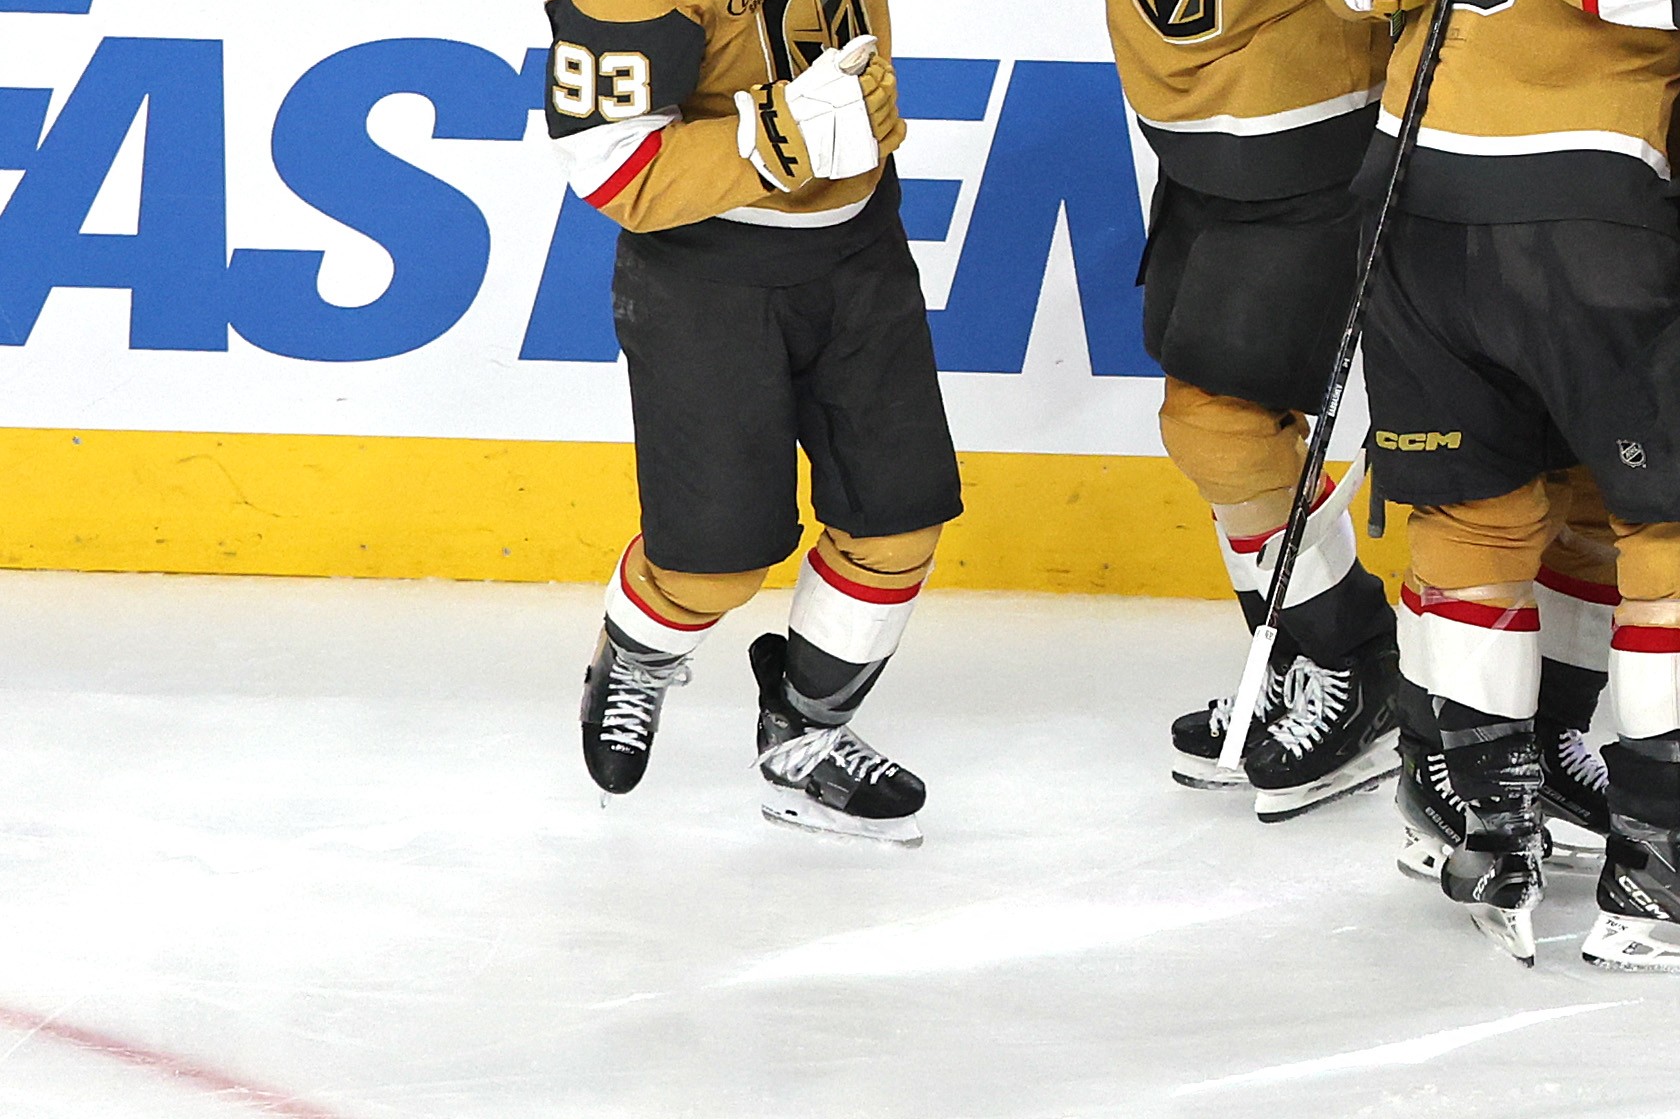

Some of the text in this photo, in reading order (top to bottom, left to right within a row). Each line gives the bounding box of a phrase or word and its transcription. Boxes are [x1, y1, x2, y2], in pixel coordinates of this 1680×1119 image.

[551, 40, 650, 122] 93
[1375, 430, 1463, 452] CCM
[1618, 875, 1671, 921] CCM
